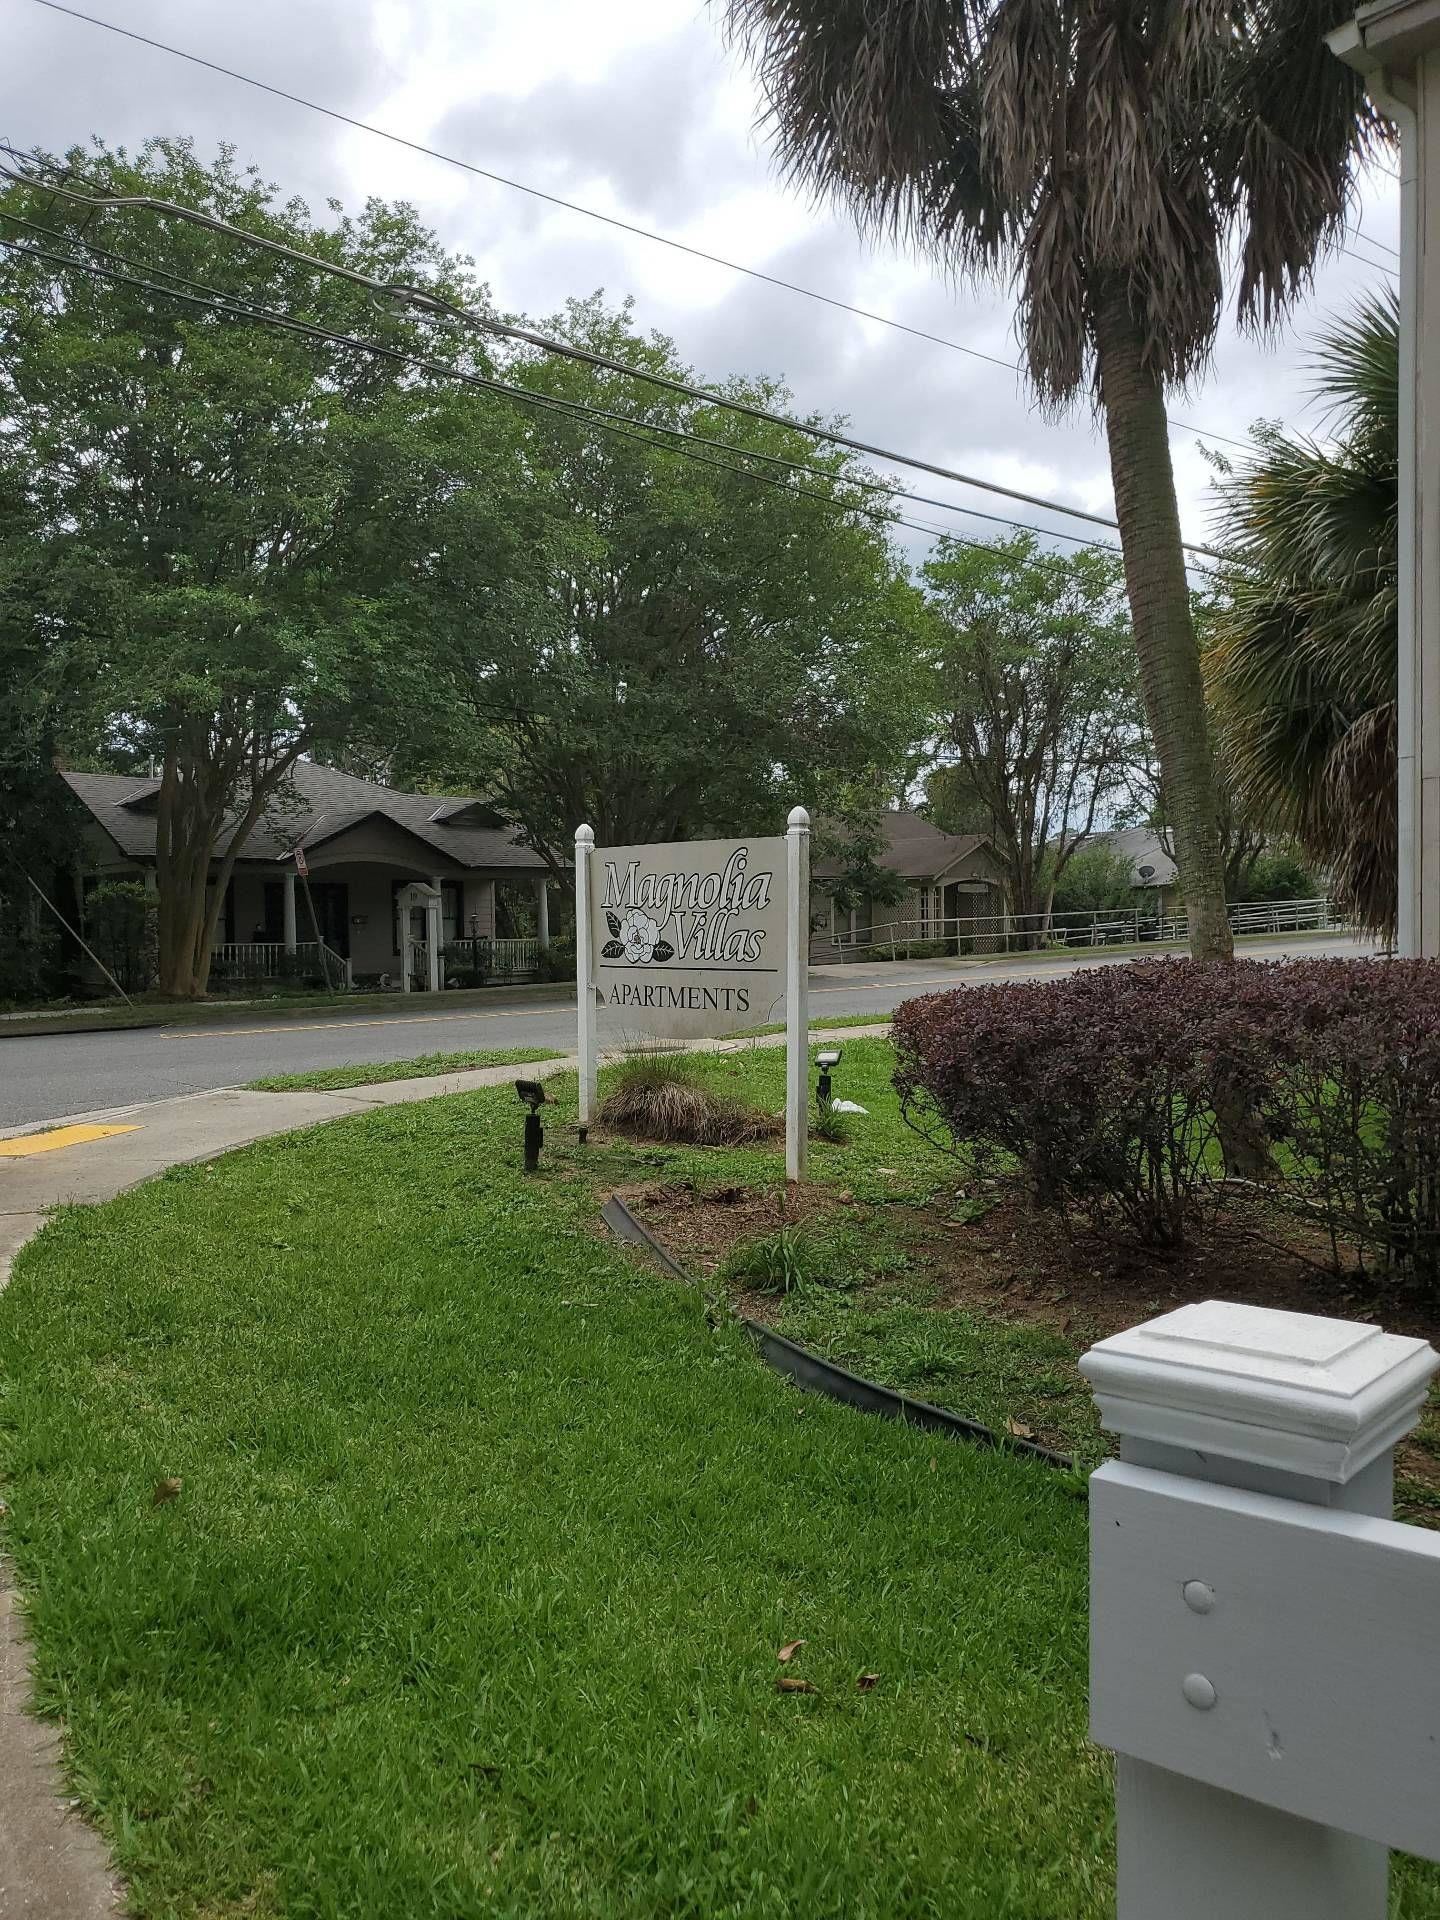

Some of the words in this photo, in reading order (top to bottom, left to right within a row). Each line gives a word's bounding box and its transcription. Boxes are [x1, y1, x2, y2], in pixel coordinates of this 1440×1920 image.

[601, 846, 773, 931] Magnolia
[671, 905, 766, 962] Villas
[609, 983, 750, 1012] APARTMENTS
